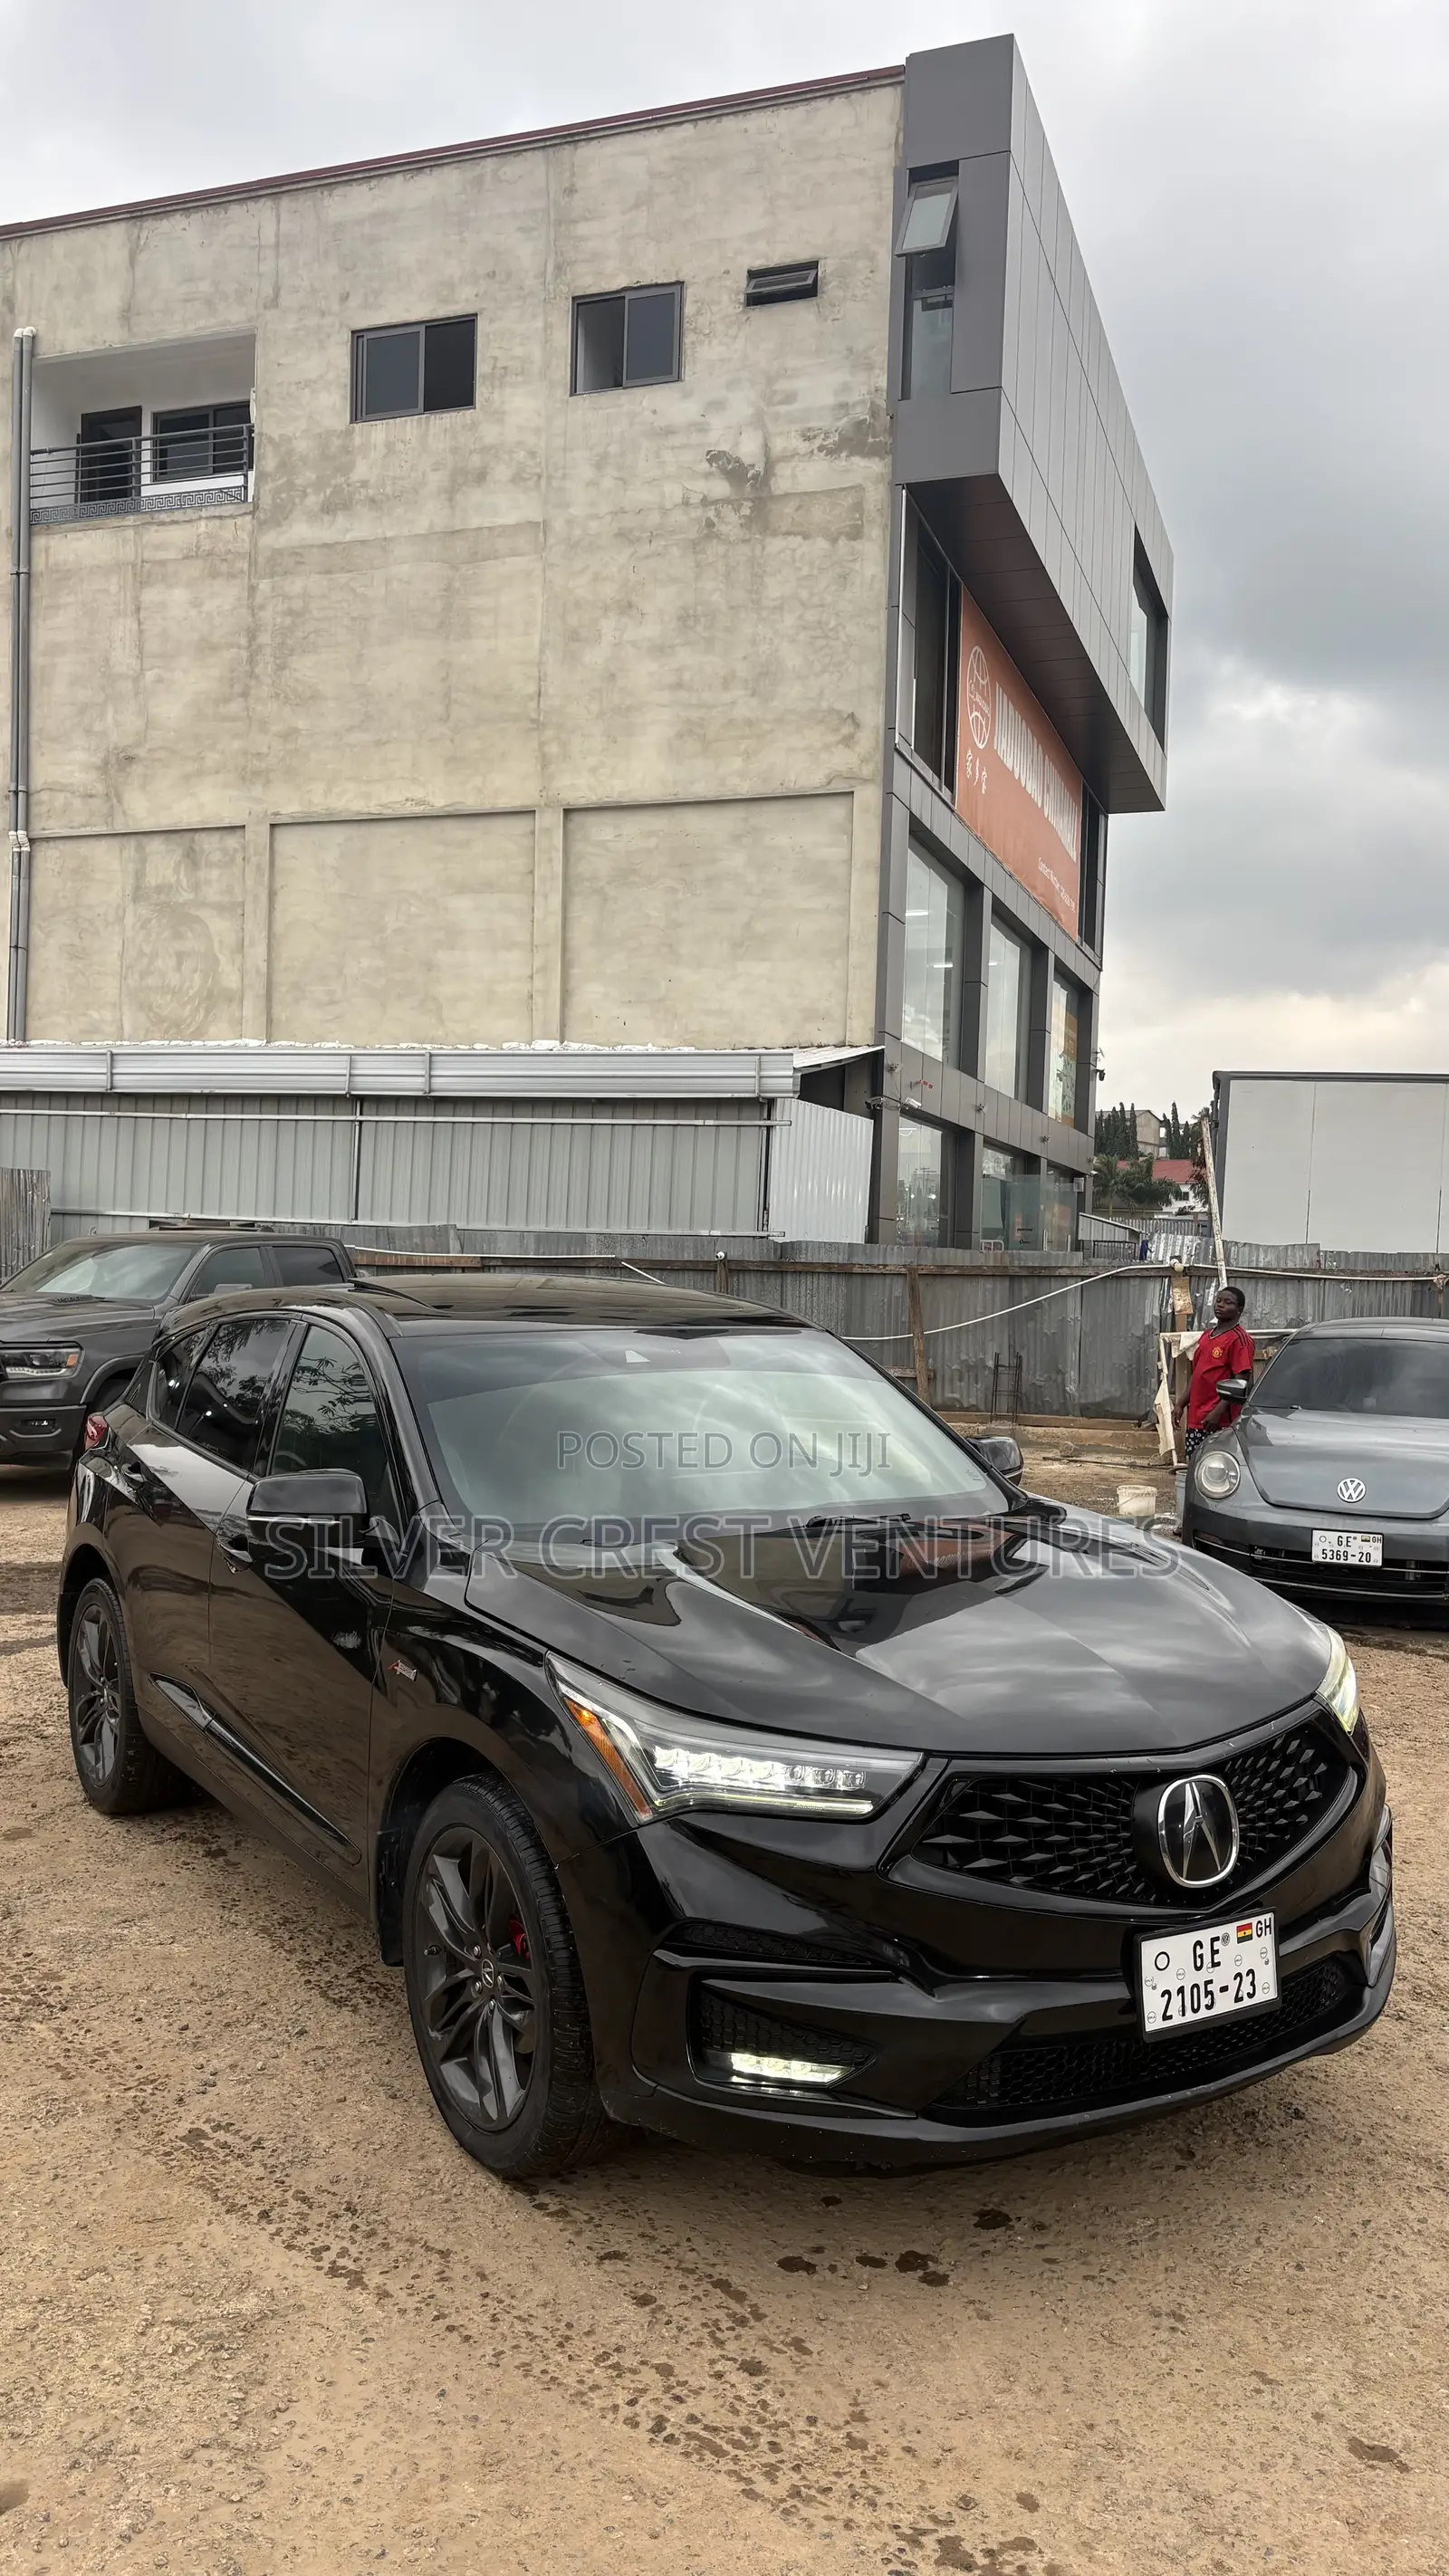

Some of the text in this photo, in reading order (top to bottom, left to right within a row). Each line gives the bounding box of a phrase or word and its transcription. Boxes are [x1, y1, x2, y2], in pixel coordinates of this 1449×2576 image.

[1337, 1535, 1352, 1547] GE
[1371, 1536, 1382, 1544] GH
[1321, 1548, 1371, 1563] 5369-20
[1255, 1917, 1272, 1938] GH
[1192, 1936, 1222, 1972] GE
[1160, 1968, 1257, 2022] 2105-23
